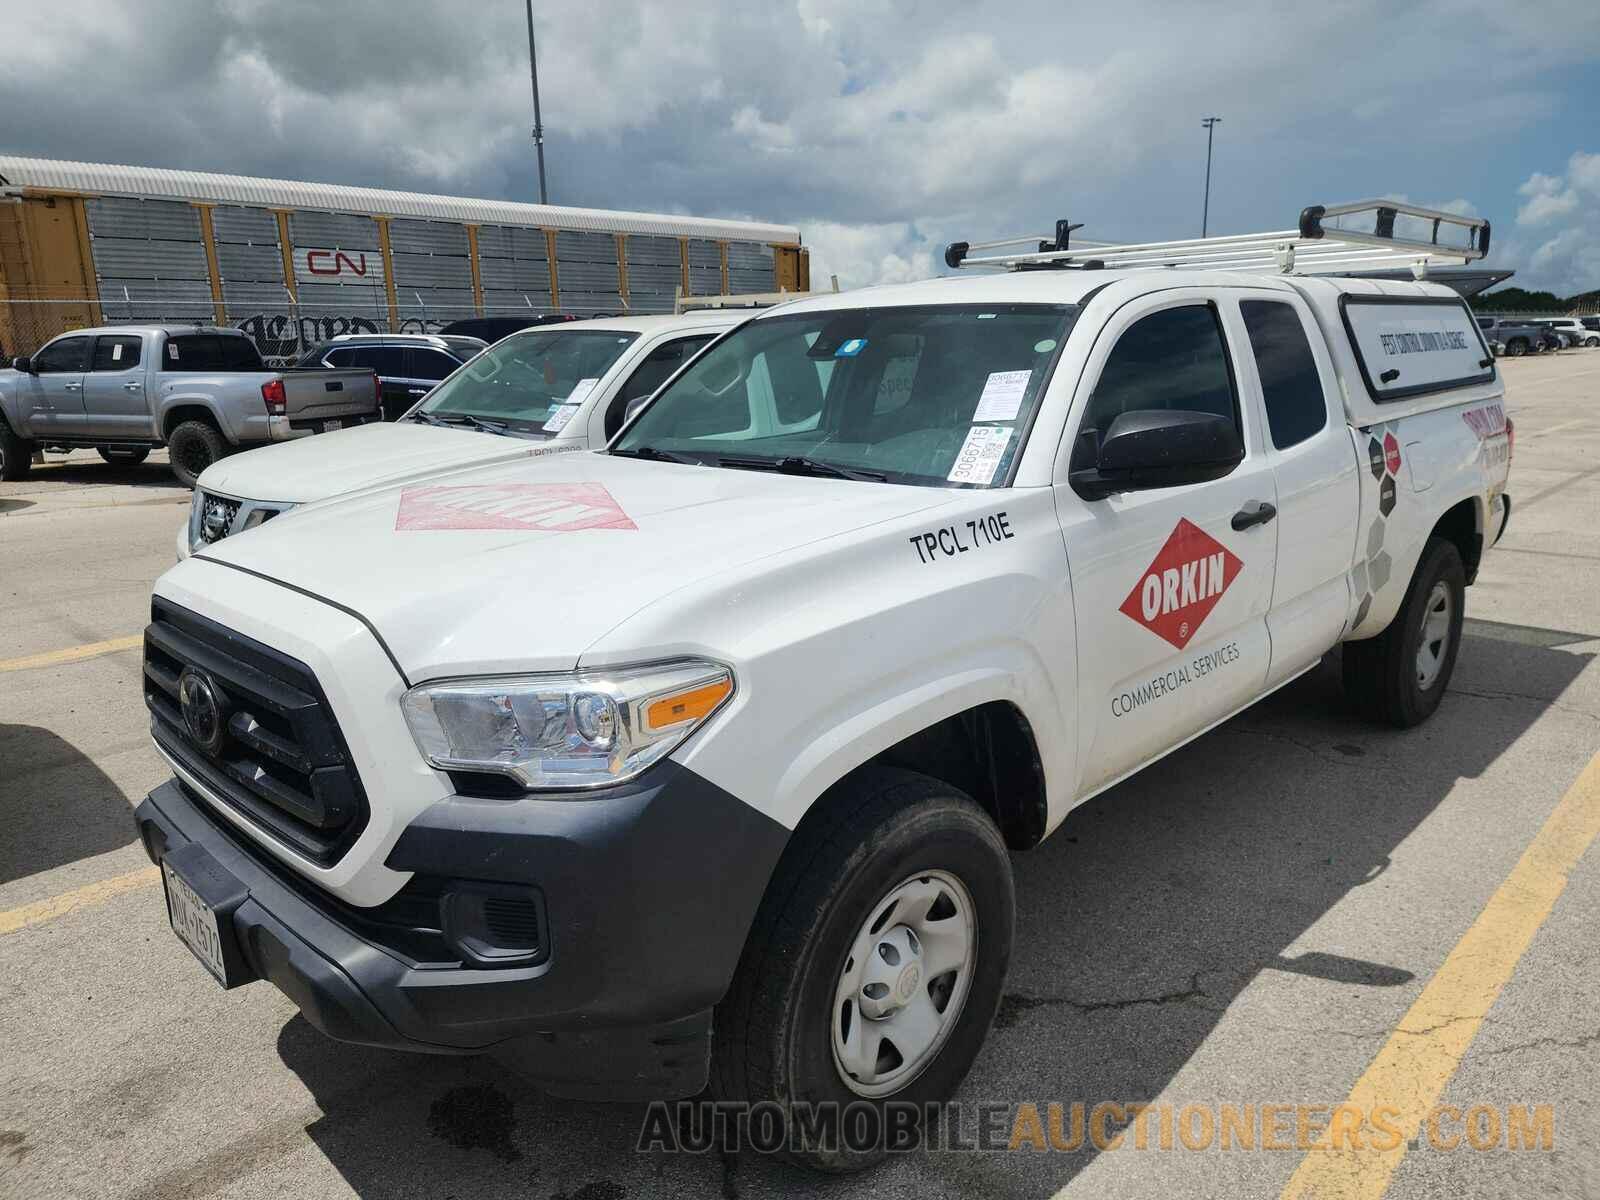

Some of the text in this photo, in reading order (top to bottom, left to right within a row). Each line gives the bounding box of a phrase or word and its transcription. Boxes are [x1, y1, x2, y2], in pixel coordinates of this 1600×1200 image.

[307, 251, 367, 276] CN
[955, 428, 989, 478] 3066715
[909, 512, 1015, 564] TPCL 710E
[1141, 551, 1225, 622] ORKIN
[1111, 642, 1240, 718] COMMERCIAL SERVICES
